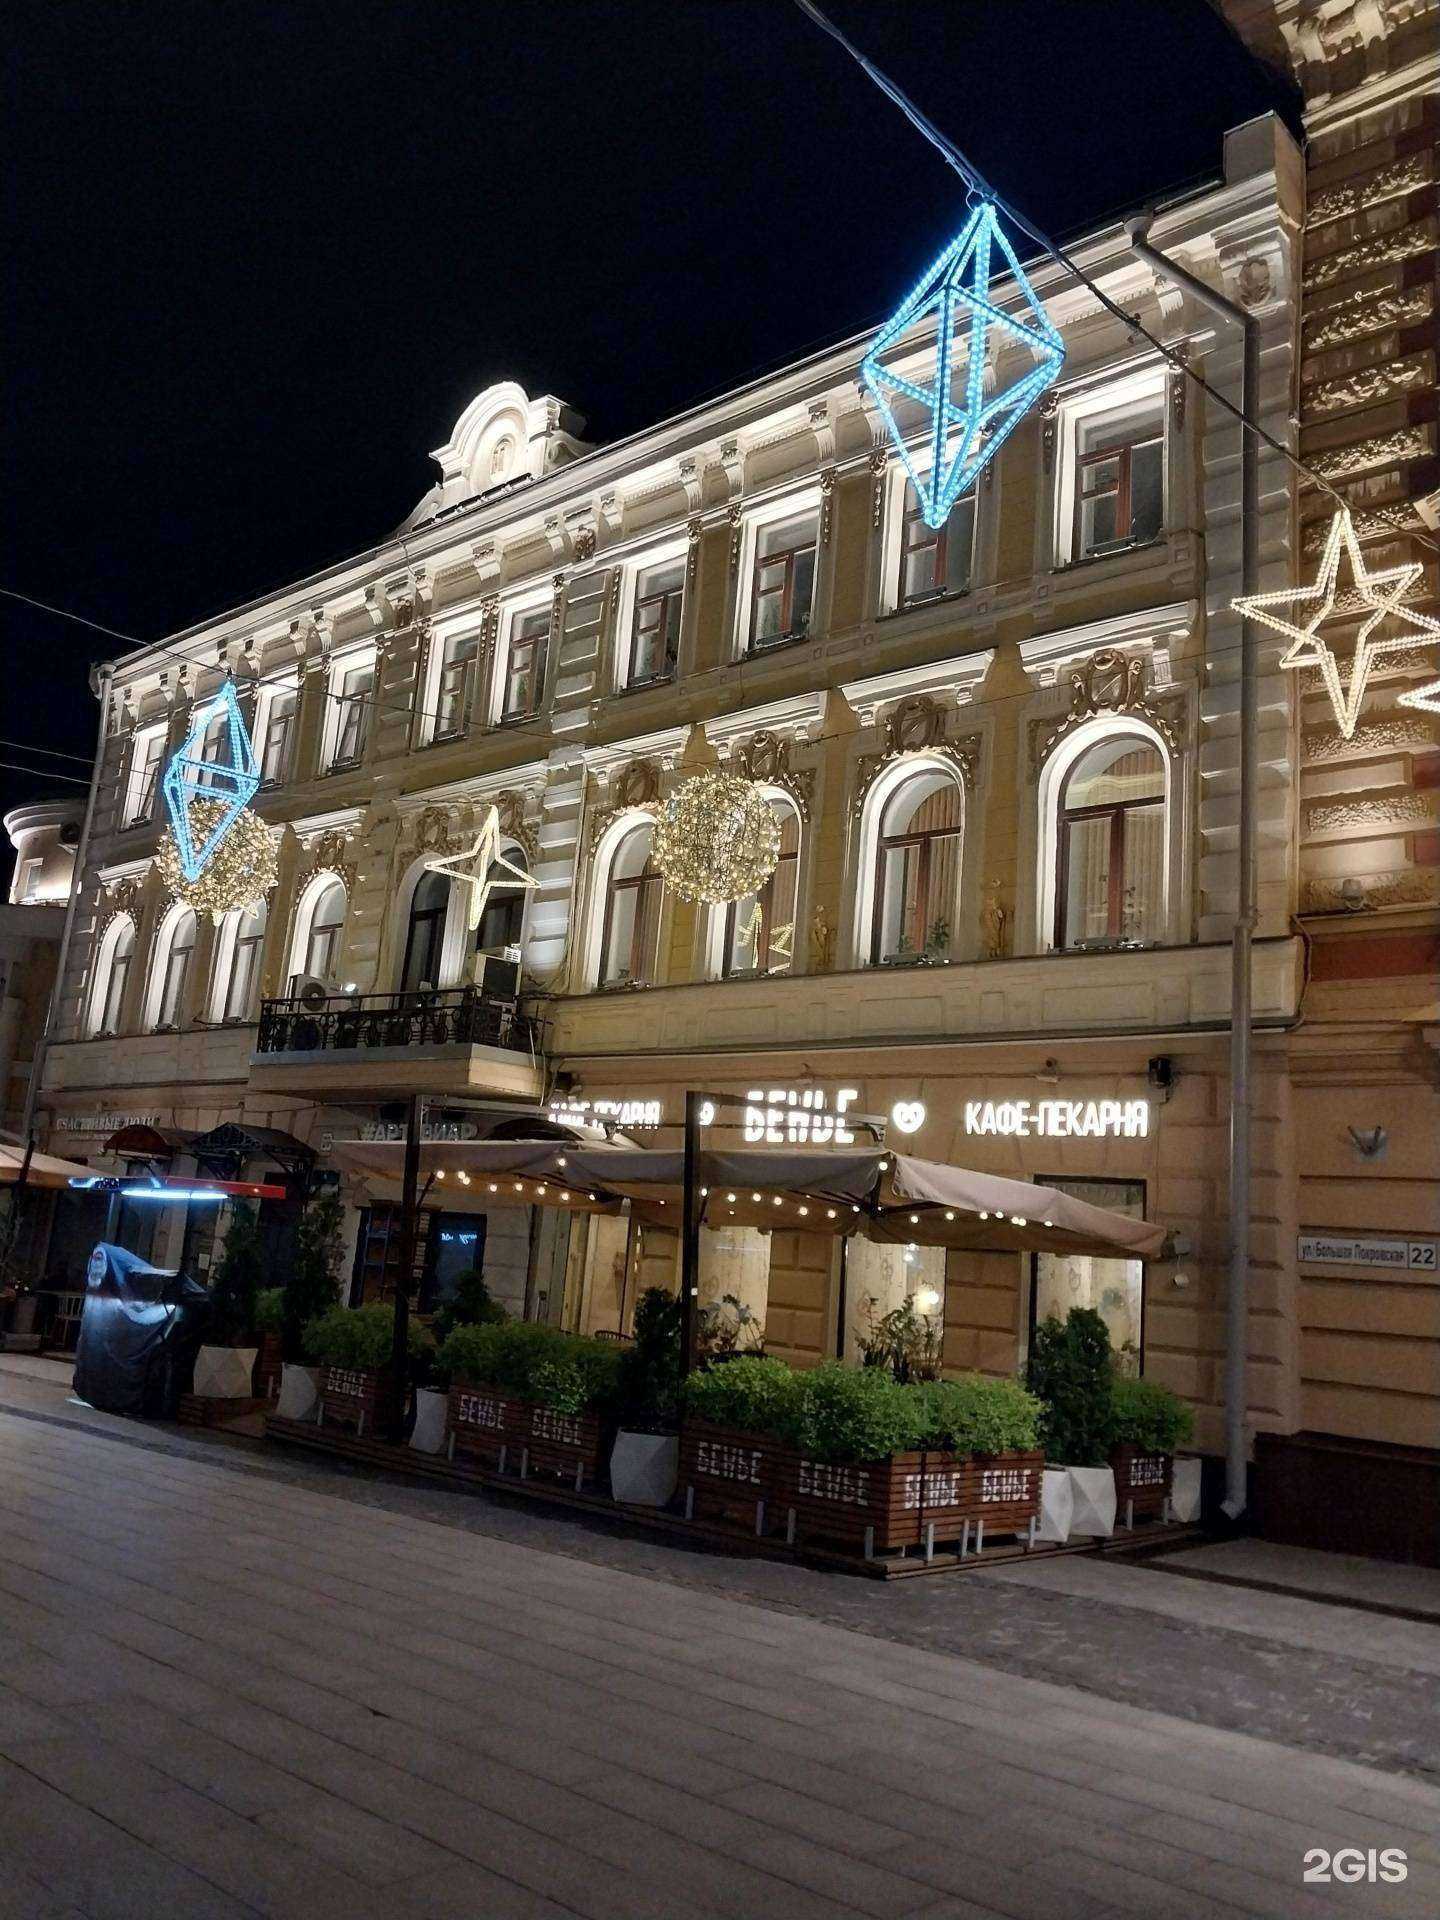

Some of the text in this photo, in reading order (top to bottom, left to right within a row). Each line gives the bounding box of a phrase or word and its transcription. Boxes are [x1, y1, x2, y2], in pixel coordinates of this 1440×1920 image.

[965, 1100, 1149, 1138] КАФЕ-ПЕКАРНЯ
[1316, 1241, 1353, 1259] Большая
[1354, 1243, 1405, 1264] Покровская
[1411, 1247, 1435, 1265] 22
